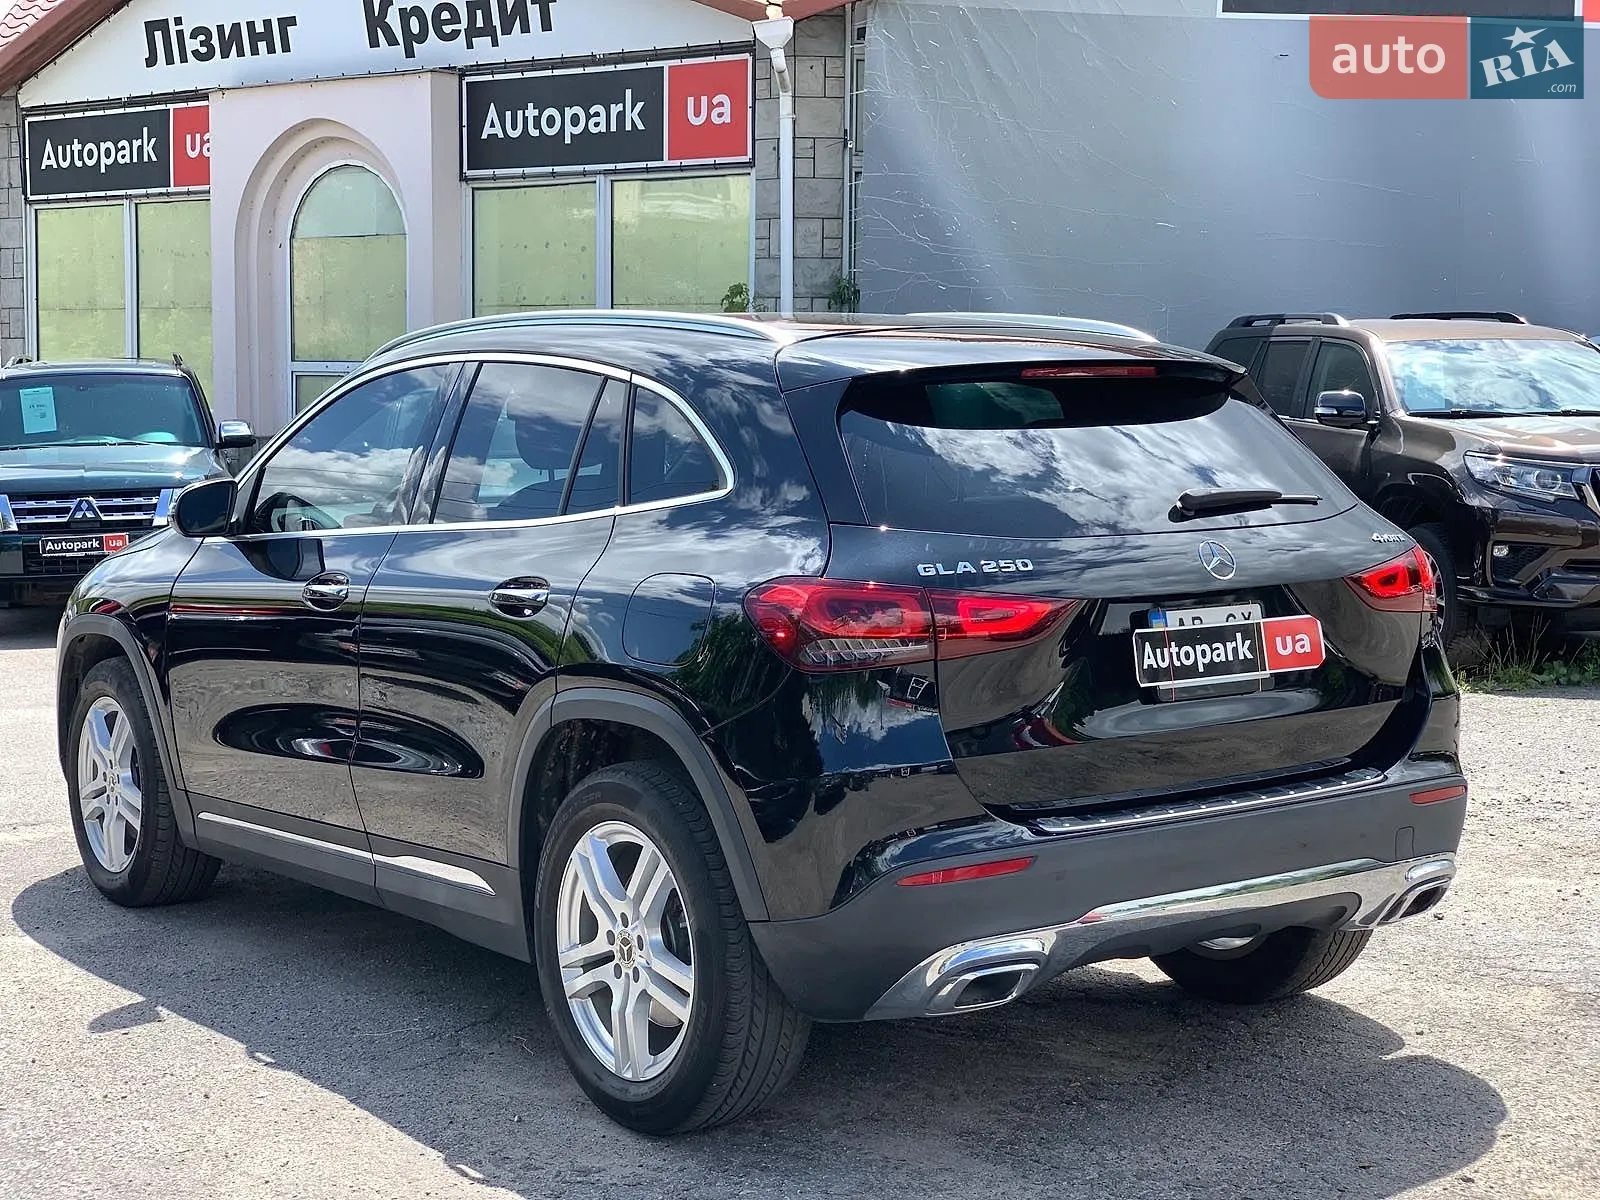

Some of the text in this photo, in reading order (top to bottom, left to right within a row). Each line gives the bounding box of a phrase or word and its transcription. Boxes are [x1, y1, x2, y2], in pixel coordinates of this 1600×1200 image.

[144, 0, 557, 68] Лізинг Кредит
[481, 88, 731, 144] Autopark ua
[41, 126, 158, 173] Autopark
[45, 539, 123, 551] Autopark ua
[917, 559, 1033, 576] GLA 250
[1143, 632, 1311, 672] Autopark ua
